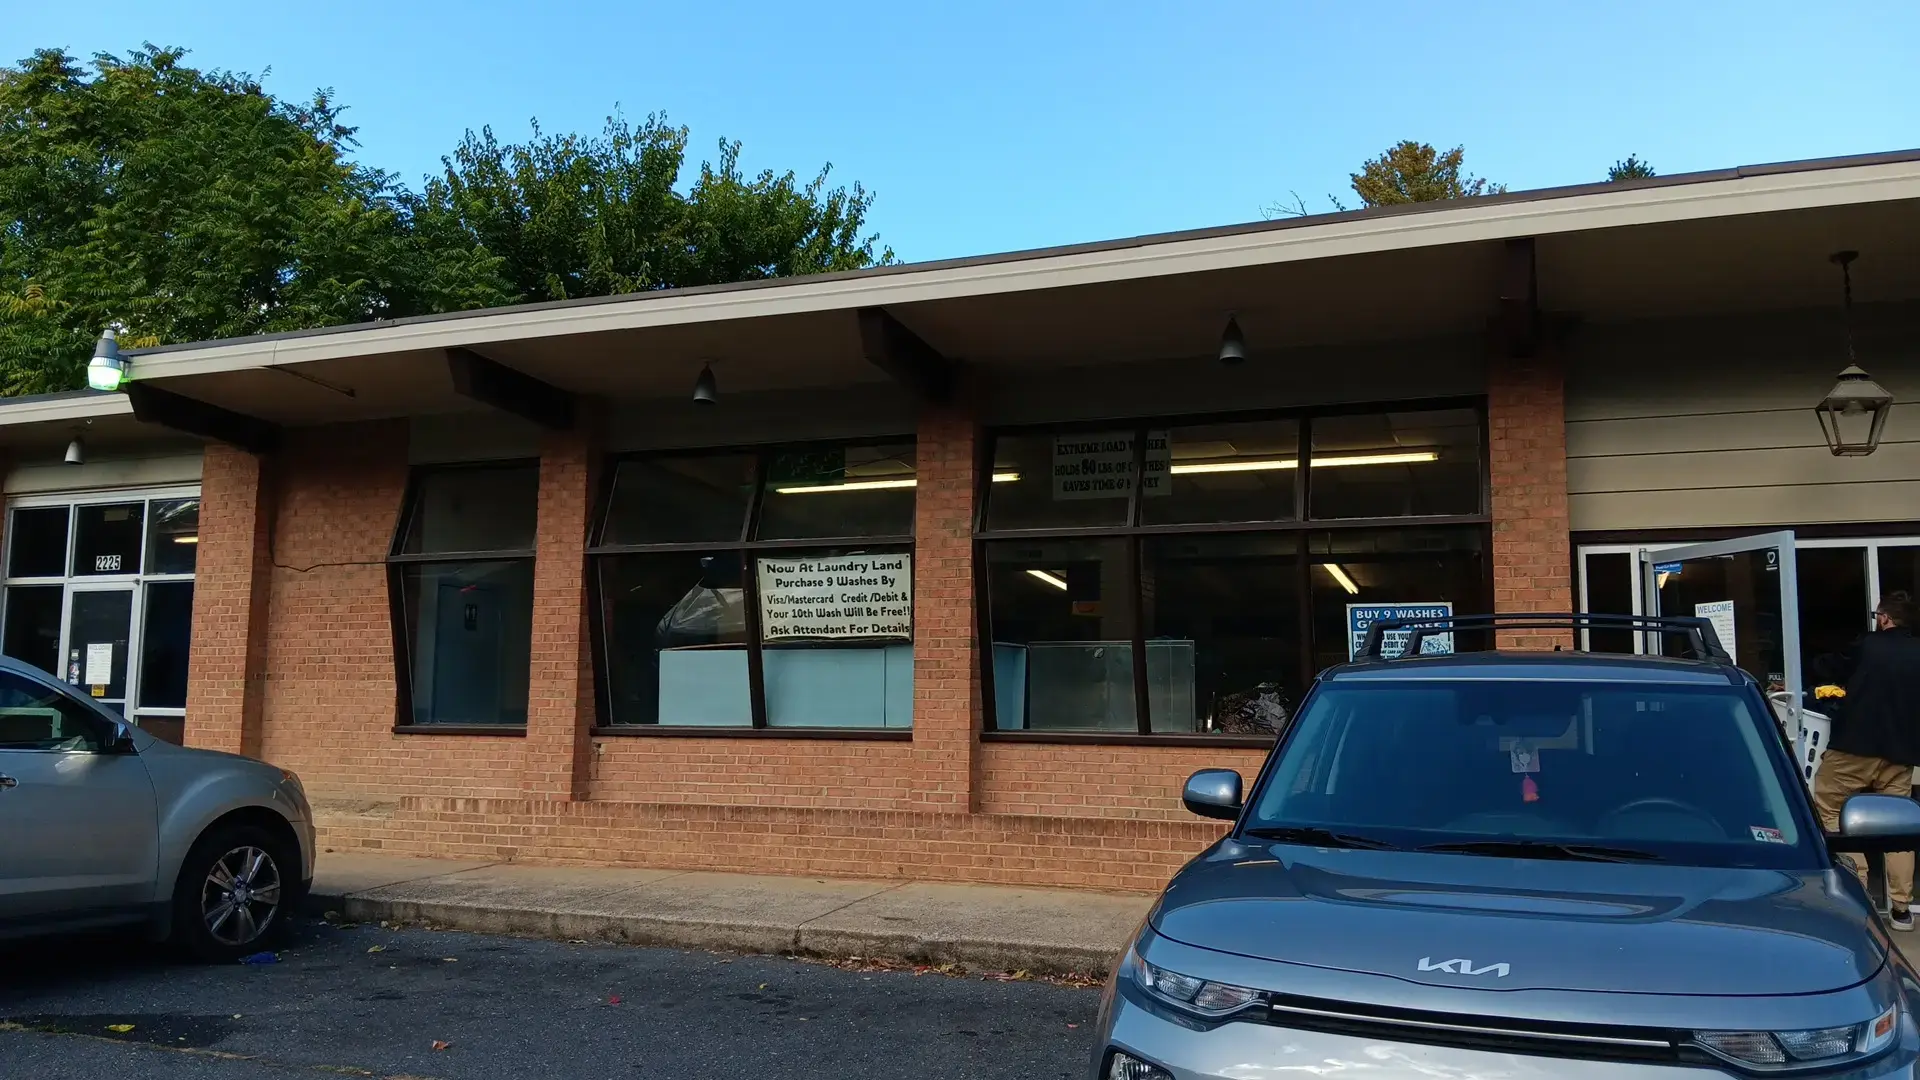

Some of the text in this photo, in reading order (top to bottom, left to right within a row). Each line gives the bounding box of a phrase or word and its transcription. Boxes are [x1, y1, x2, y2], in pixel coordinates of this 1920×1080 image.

[1056, 441, 1099, 455] EXTREME
[1101, 440, 1126, 453] LOAD
[1054, 463, 1080, 476] HOLDS
[1116, 461, 1127, 474] OF
[1092, 478, 1115, 491] TIME
[97, 555, 120, 570] 2225
[766, 559, 903, 574] Now At Laundry Land
[775, 575, 896, 588] Purchase 9 Washes By
[766, 593, 834, 605] Visa/Mastercard
[840, 592, 868, 604] Credit
[900, 591, 909, 602] &
[766, 608, 789, 619] Your
[791, 608, 813, 619] 10th
[815, 607, 842, 618] Wash
[843, 606, 864, 617] Will
[866, 606, 878, 617] Be
[1355, 609, 1444, 619] BUY 9 WASHES
[1696, 602, 1733, 614] WELCOME
[770, 622, 910, 635] Ask Attendant For Details
[1386, 632, 1398, 641] USE
[1383, 641, 1398, 649] DEBIT
[1417, 956, 1510, 978] KIA
